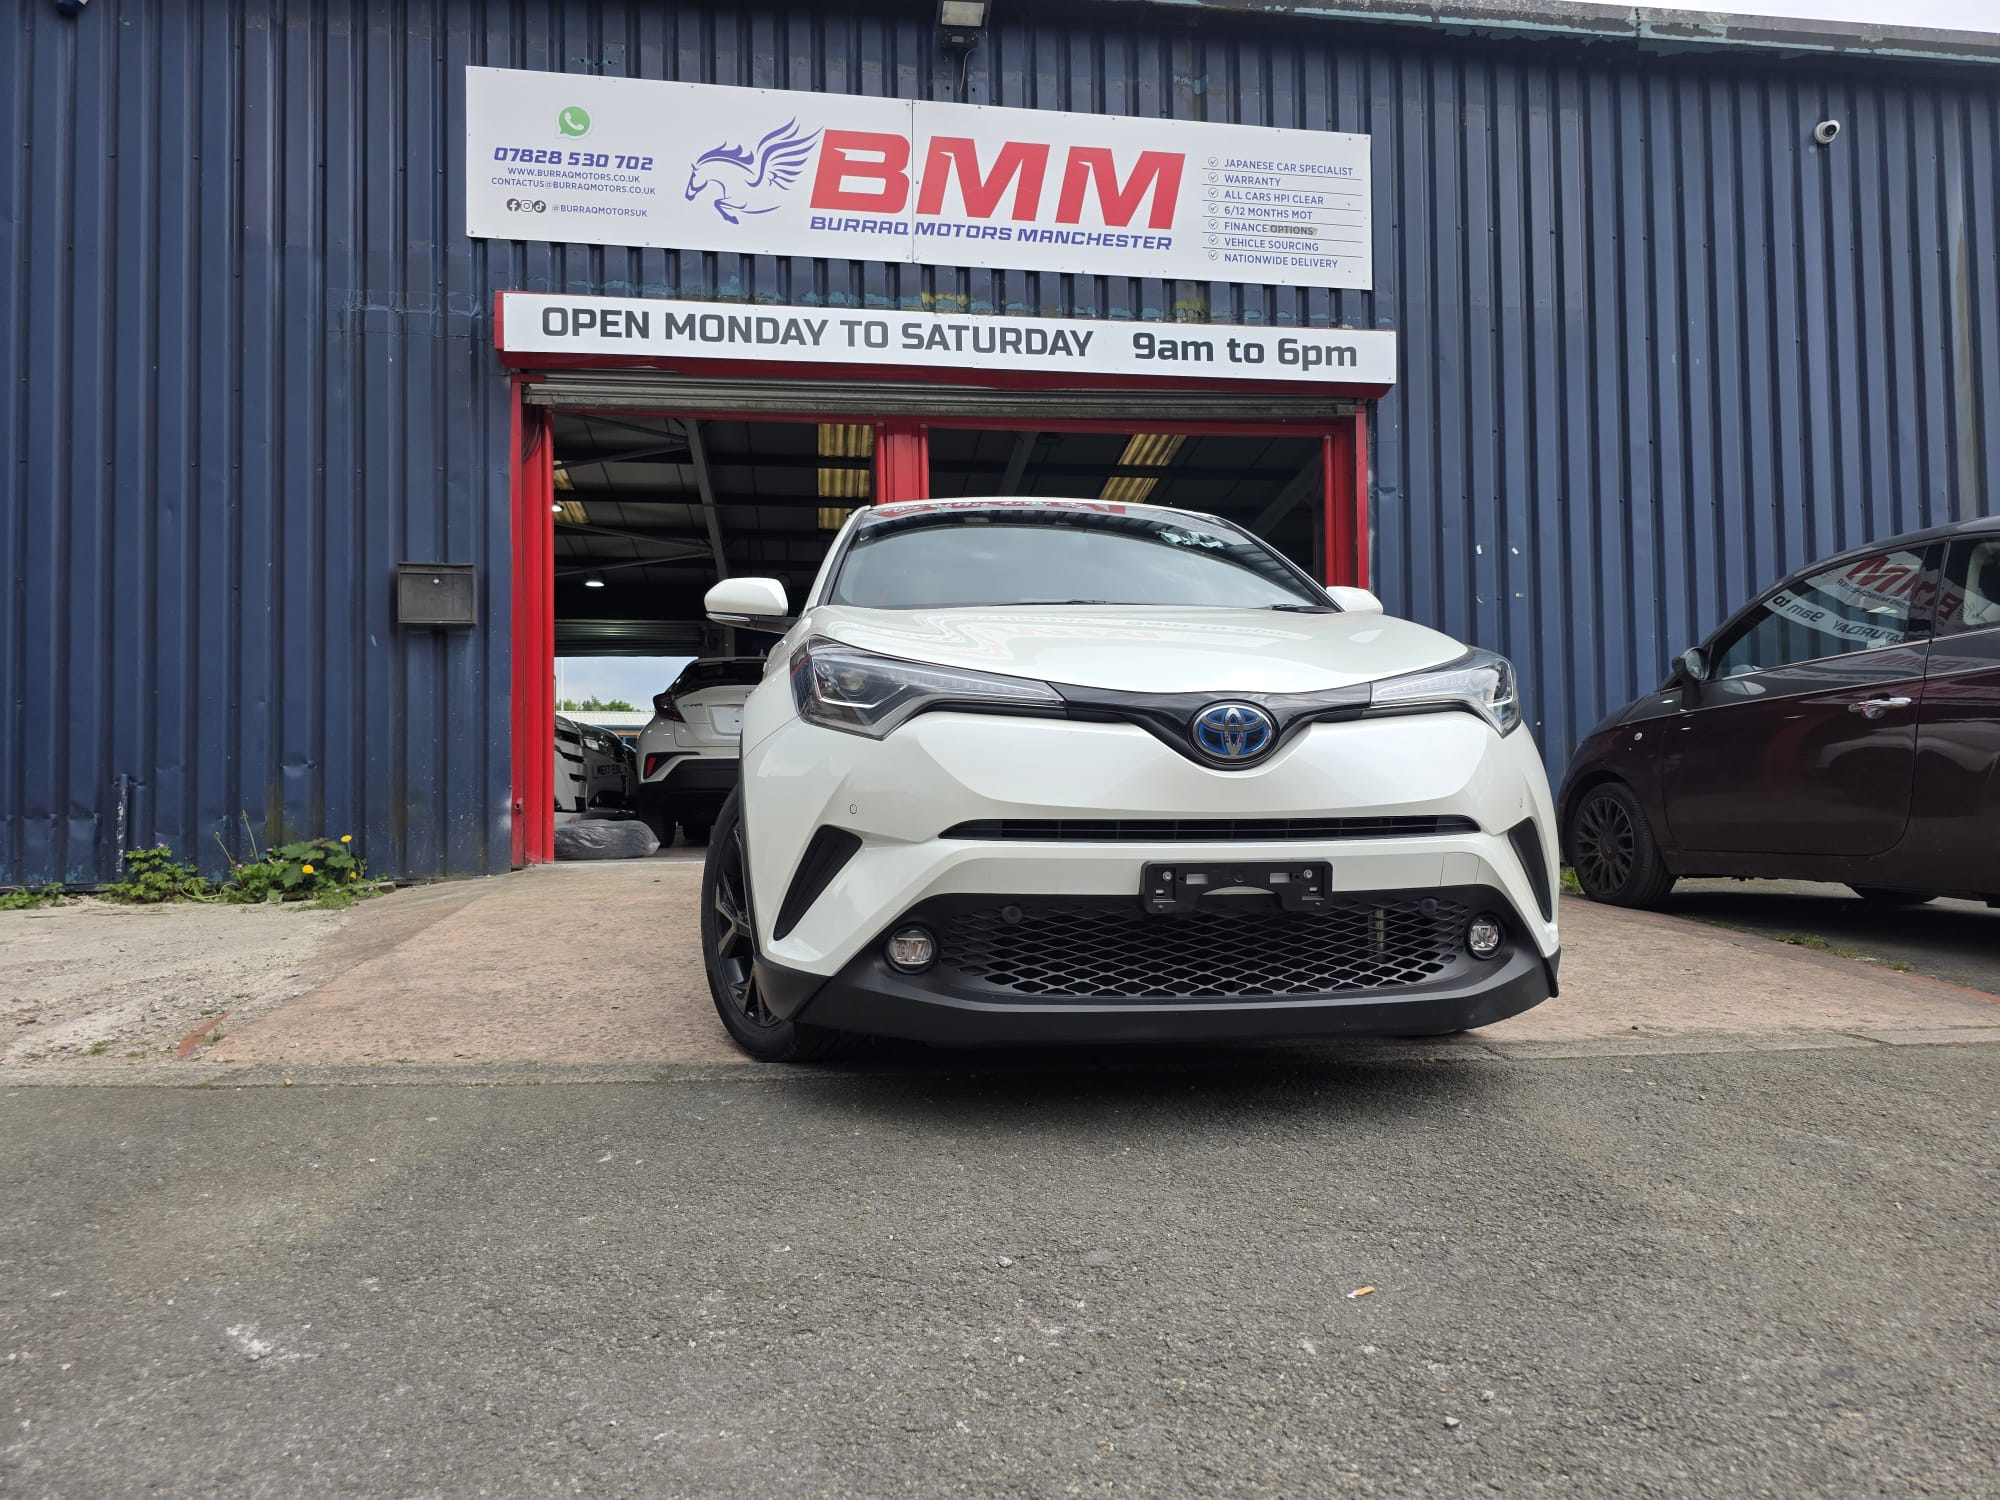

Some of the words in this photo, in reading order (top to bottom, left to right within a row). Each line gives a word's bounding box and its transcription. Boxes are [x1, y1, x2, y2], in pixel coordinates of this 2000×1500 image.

[494, 147, 562, 164] 07828
[568, 152, 609, 167] 530
[615, 155, 654, 170] 702
[508, 167, 640, 183] WWW.BURRAQMOTORS.CO.UK
[1224, 159, 1274, 171] JAPANESE
[1277, 162, 1296, 172] CAR
[1299, 164, 1353, 176] SPECIALIST
[491, 178, 656, 195] CONTACTUS@BURRAQMOTORS.CO.UK
[810, 129, 1186, 230] BMM
[1224, 174, 1281, 186] WARRANTY
[1224, 190, 1242, 199] ALL
[1245, 192, 1271, 202] CARS
[1274, 193, 1289, 203] HPI
[1294, 195, 1324, 205] CLEAR
[552, 204, 648, 217] @BURRAQMOTORSUK
[1224, 206, 1245, 216] 6/12
[1248, 208, 1288, 218] MONTHS
[1292, 210, 1312, 220] MOT
[810, 216, 909, 236] BURRAQ
[915, 222, 1012, 241] MOTORS
[1017, 228, 1172, 250] MANCHESTER
[1224, 222, 1267, 233] FINANCE
[1270, 224, 1314, 235] OPTIONS
[1224, 238, 1265, 249] VEHICLE
[1268, 240, 1319, 251] SOURCING
[1224, 253, 1288, 266] NATIONWIDE
[1291, 257, 1338, 268] DELIVERY
[542, 306, 650, 339] OPEN
[665, 312, 829, 346] MONDAY
[840, 320, 889, 349] TO
[902, 322, 1094, 357] SATURDAY
[1133, 332, 1214, 362] 9am
[1227, 338, 1264, 364] to
[1278, 338, 1358, 372] 6pm
